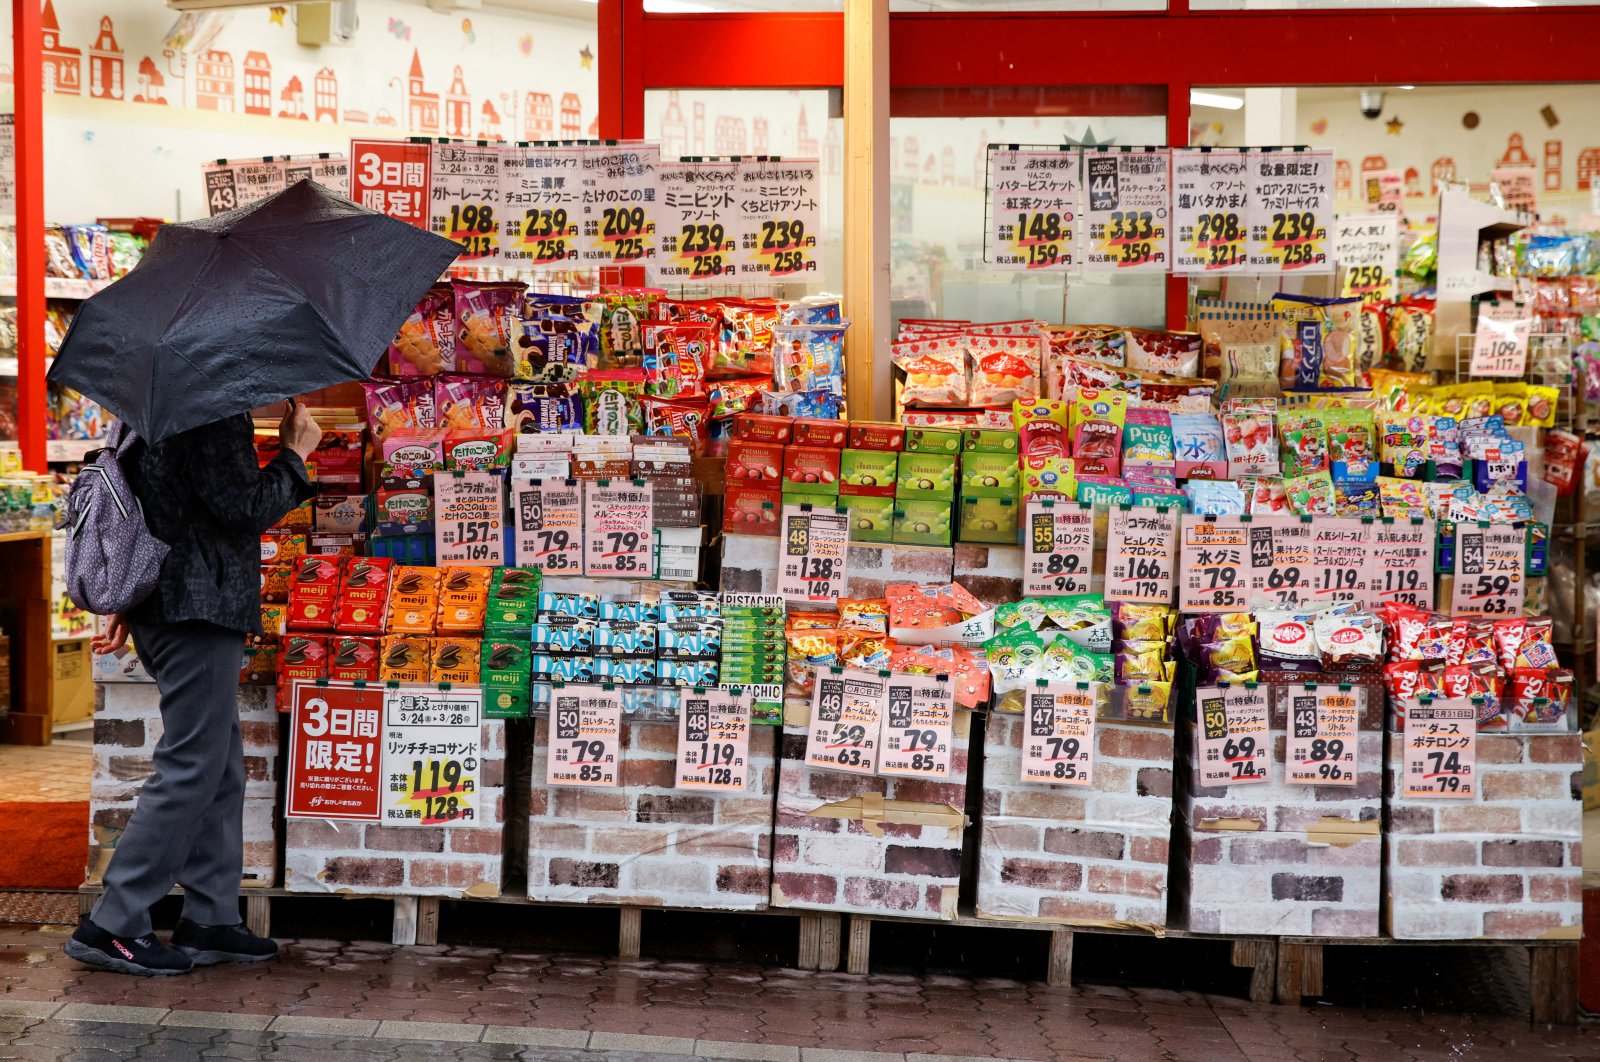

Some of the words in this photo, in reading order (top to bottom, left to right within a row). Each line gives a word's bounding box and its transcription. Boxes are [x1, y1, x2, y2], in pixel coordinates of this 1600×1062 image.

[1029, 159, 1069, 169] おすすめ
[1260, 162, 1319, 177] 数量限定!
[358, 152, 424, 189] 3日間
[743, 170, 814, 181] おいしさいろいろ
[1027, 172, 1052, 180] りんごの
[583, 188, 655, 203] たけのこの里
[760, 185, 807, 197] ミニビット
[505, 192, 580, 203] チョコブラウニー
[664, 192, 735, 208] ミニビット
[1261, 196, 1320, 210] ファミリーサイズ
[362, 189, 421, 220] 限定!
[741, 199, 818, 213] くちどけアソート
[682, 210, 720, 221] アソート
[1301, 325, 1318, 384] ロアンヌ
[1028, 421, 1062, 433] APPLE
[1083, 421, 1117, 435] APPLE
[454, 445, 495, 457] たけのこの里
[742, 448, 769, 458] PREMIUM
[1183, 437, 1206, 459] 水
[395, 450, 431, 460] きのこの山
[386, 498, 428, 509] たけのこの里
[1055, 532, 1091, 545] 4Dグミ
[1124, 535, 1166, 547] ピュレグミ
[1276, 544, 1310, 555] 果汁グミ
[1197, 549, 1241, 566] 水グミ
[1486, 559, 1520, 572] ラムネ
[300, 585, 327, 597] meiji
[349, 590, 377, 601] meiji
[450, 592, 478, 601] meiji
[401, 595, 428, 604] meiji
[499, 600, 526, 608] meiji
[964, 621, 982, 634] 大玉
[1090, 627, 1108, 639] 大玉
[400, 695, 429, 711] 週末
[431, 703, 470, 712] とびきり価格!
[932, 702, 946, 711] 大玉
[302, 697, 379, 739] 3日間
[912, 709, 950, 720] チョコボール
[1055, 715, 1092, 725] チョコボール
[1319, 714, 1355, 724] キットカット
[582, 717, 615, 727] 白いダース
[710, 721, 746, 733] ピスタチオ
[1227, 716, 1265, 727] クランキー
[1327, 723, 1346, 731] リトル
[1428, 723, 1460, 735] ダース
[388, 731, 403, 740] 明治
[718, 731, 738, 740] チョコ
[1413, 736, 1471, 749] ポテロング
[388, 742, 478, 757] リッチチョコサンド
[305, 740, 374, 773] 限定!
